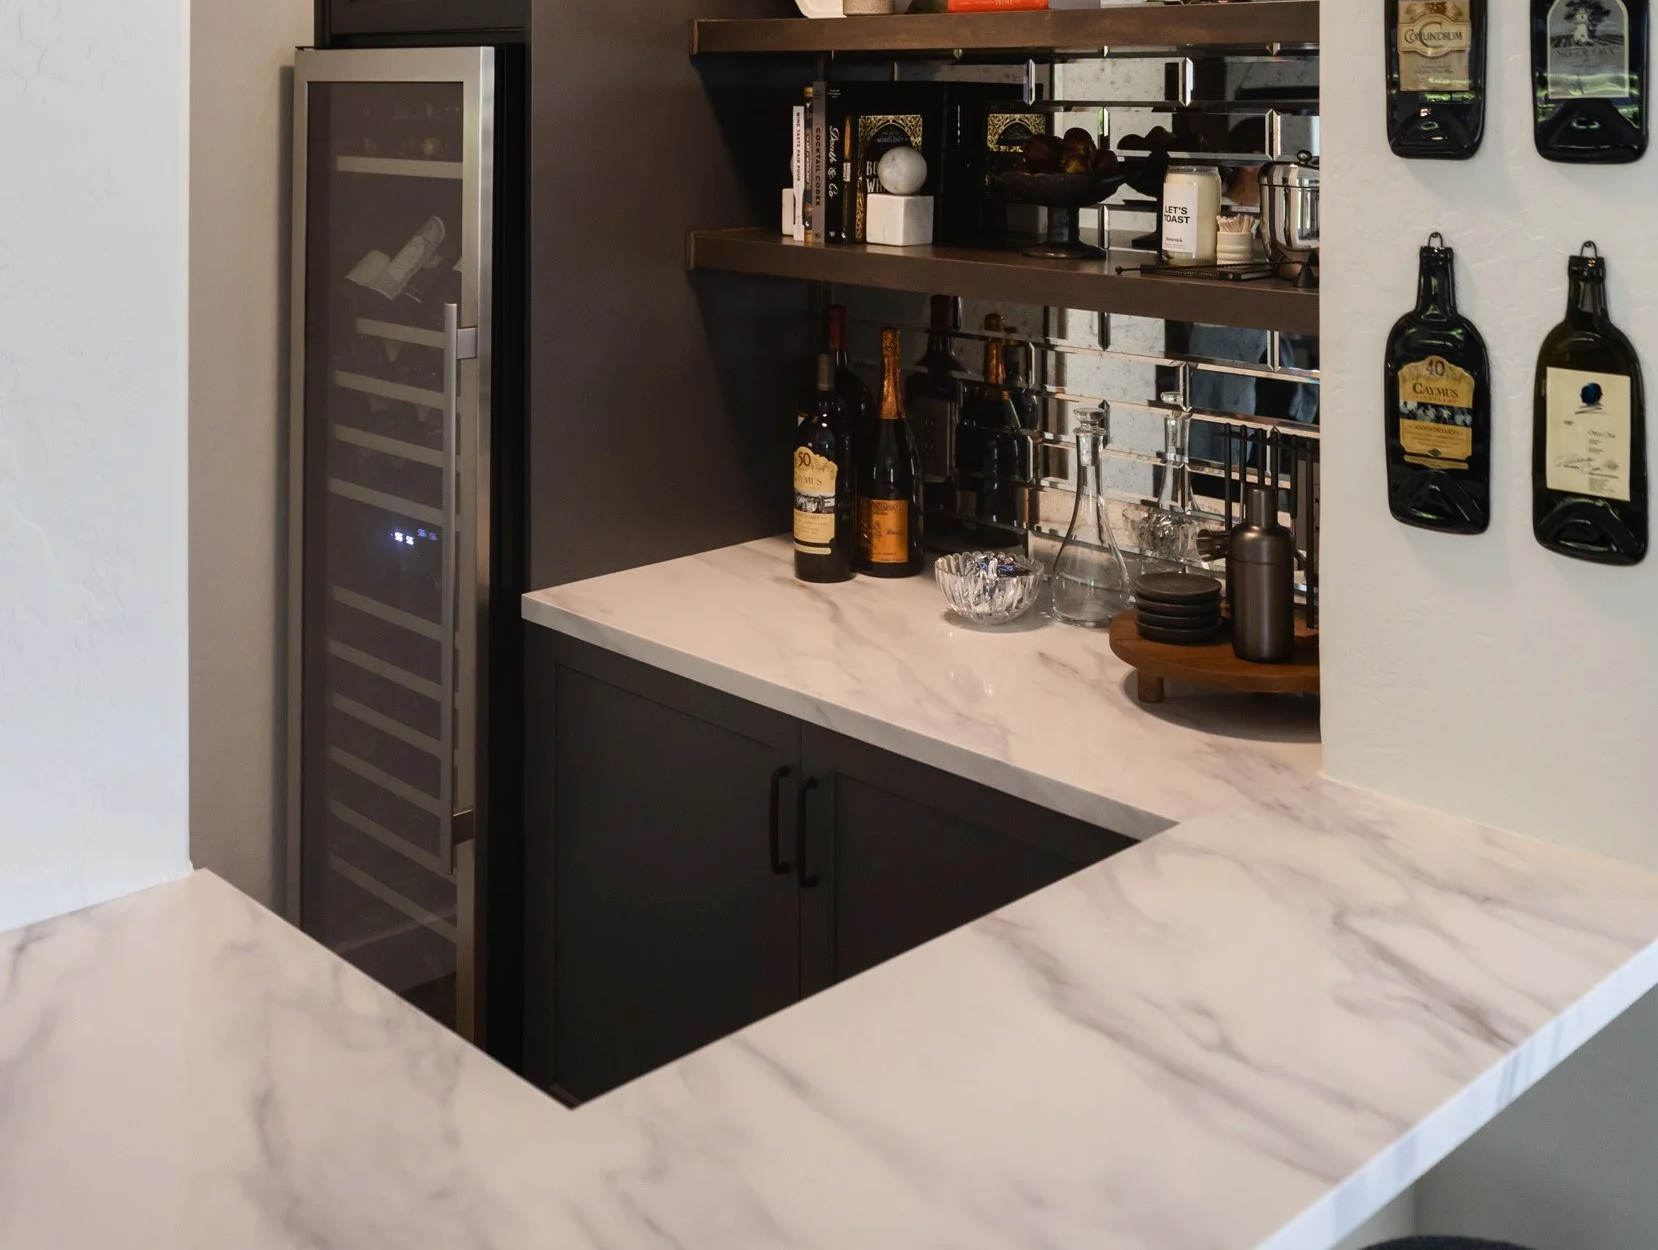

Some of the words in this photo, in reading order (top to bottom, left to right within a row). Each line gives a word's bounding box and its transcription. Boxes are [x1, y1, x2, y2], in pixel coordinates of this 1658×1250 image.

[829, 125, 840, 165] Death
[827, 166, 838, 180] &
[828, 182, 839, 199] Co
[1165, 206, 1188, 215] LET'S
[1163, 214, 1191, 224] TOAST
[1425, 359, 1445, 377] 40
[1412, 381, 1459, 399] CAYMUS
[797, 452, 811, 467] 50
